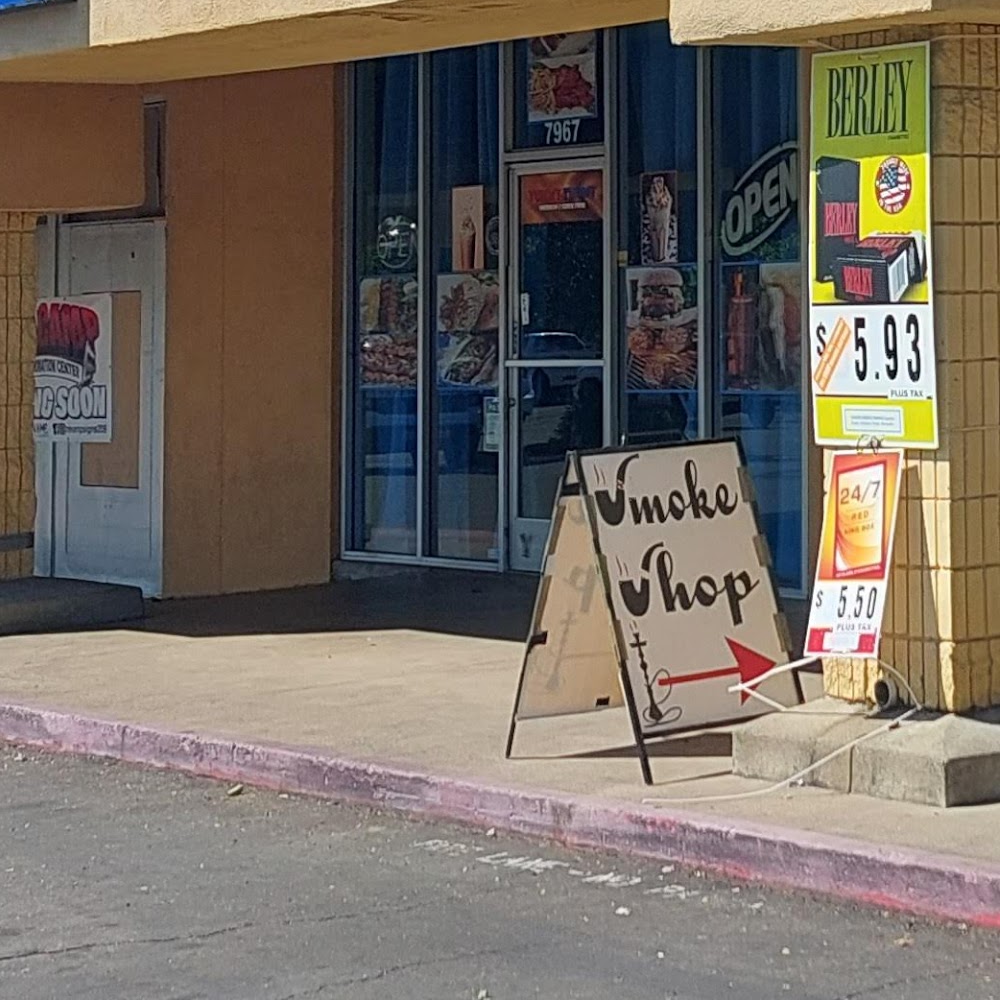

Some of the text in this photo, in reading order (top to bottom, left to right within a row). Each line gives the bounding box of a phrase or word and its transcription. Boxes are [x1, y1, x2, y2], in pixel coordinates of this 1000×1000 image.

[826, 60, 913, 138] BERLEY
[544, 118, 580, 145] 7967
[724, 151, 798, 244] OPEN
[854, 313, 921, 383] 5.93
[54, 385, 107, 420] SOON
[890, 389, 924, 398] PLUS TAX
[841, 481, 881, 506] 24/7
[851, 510, 869, 521] RED
[815, 585, 878, 619] $ 5.50
[836, 623, 856, 631] PLUS
